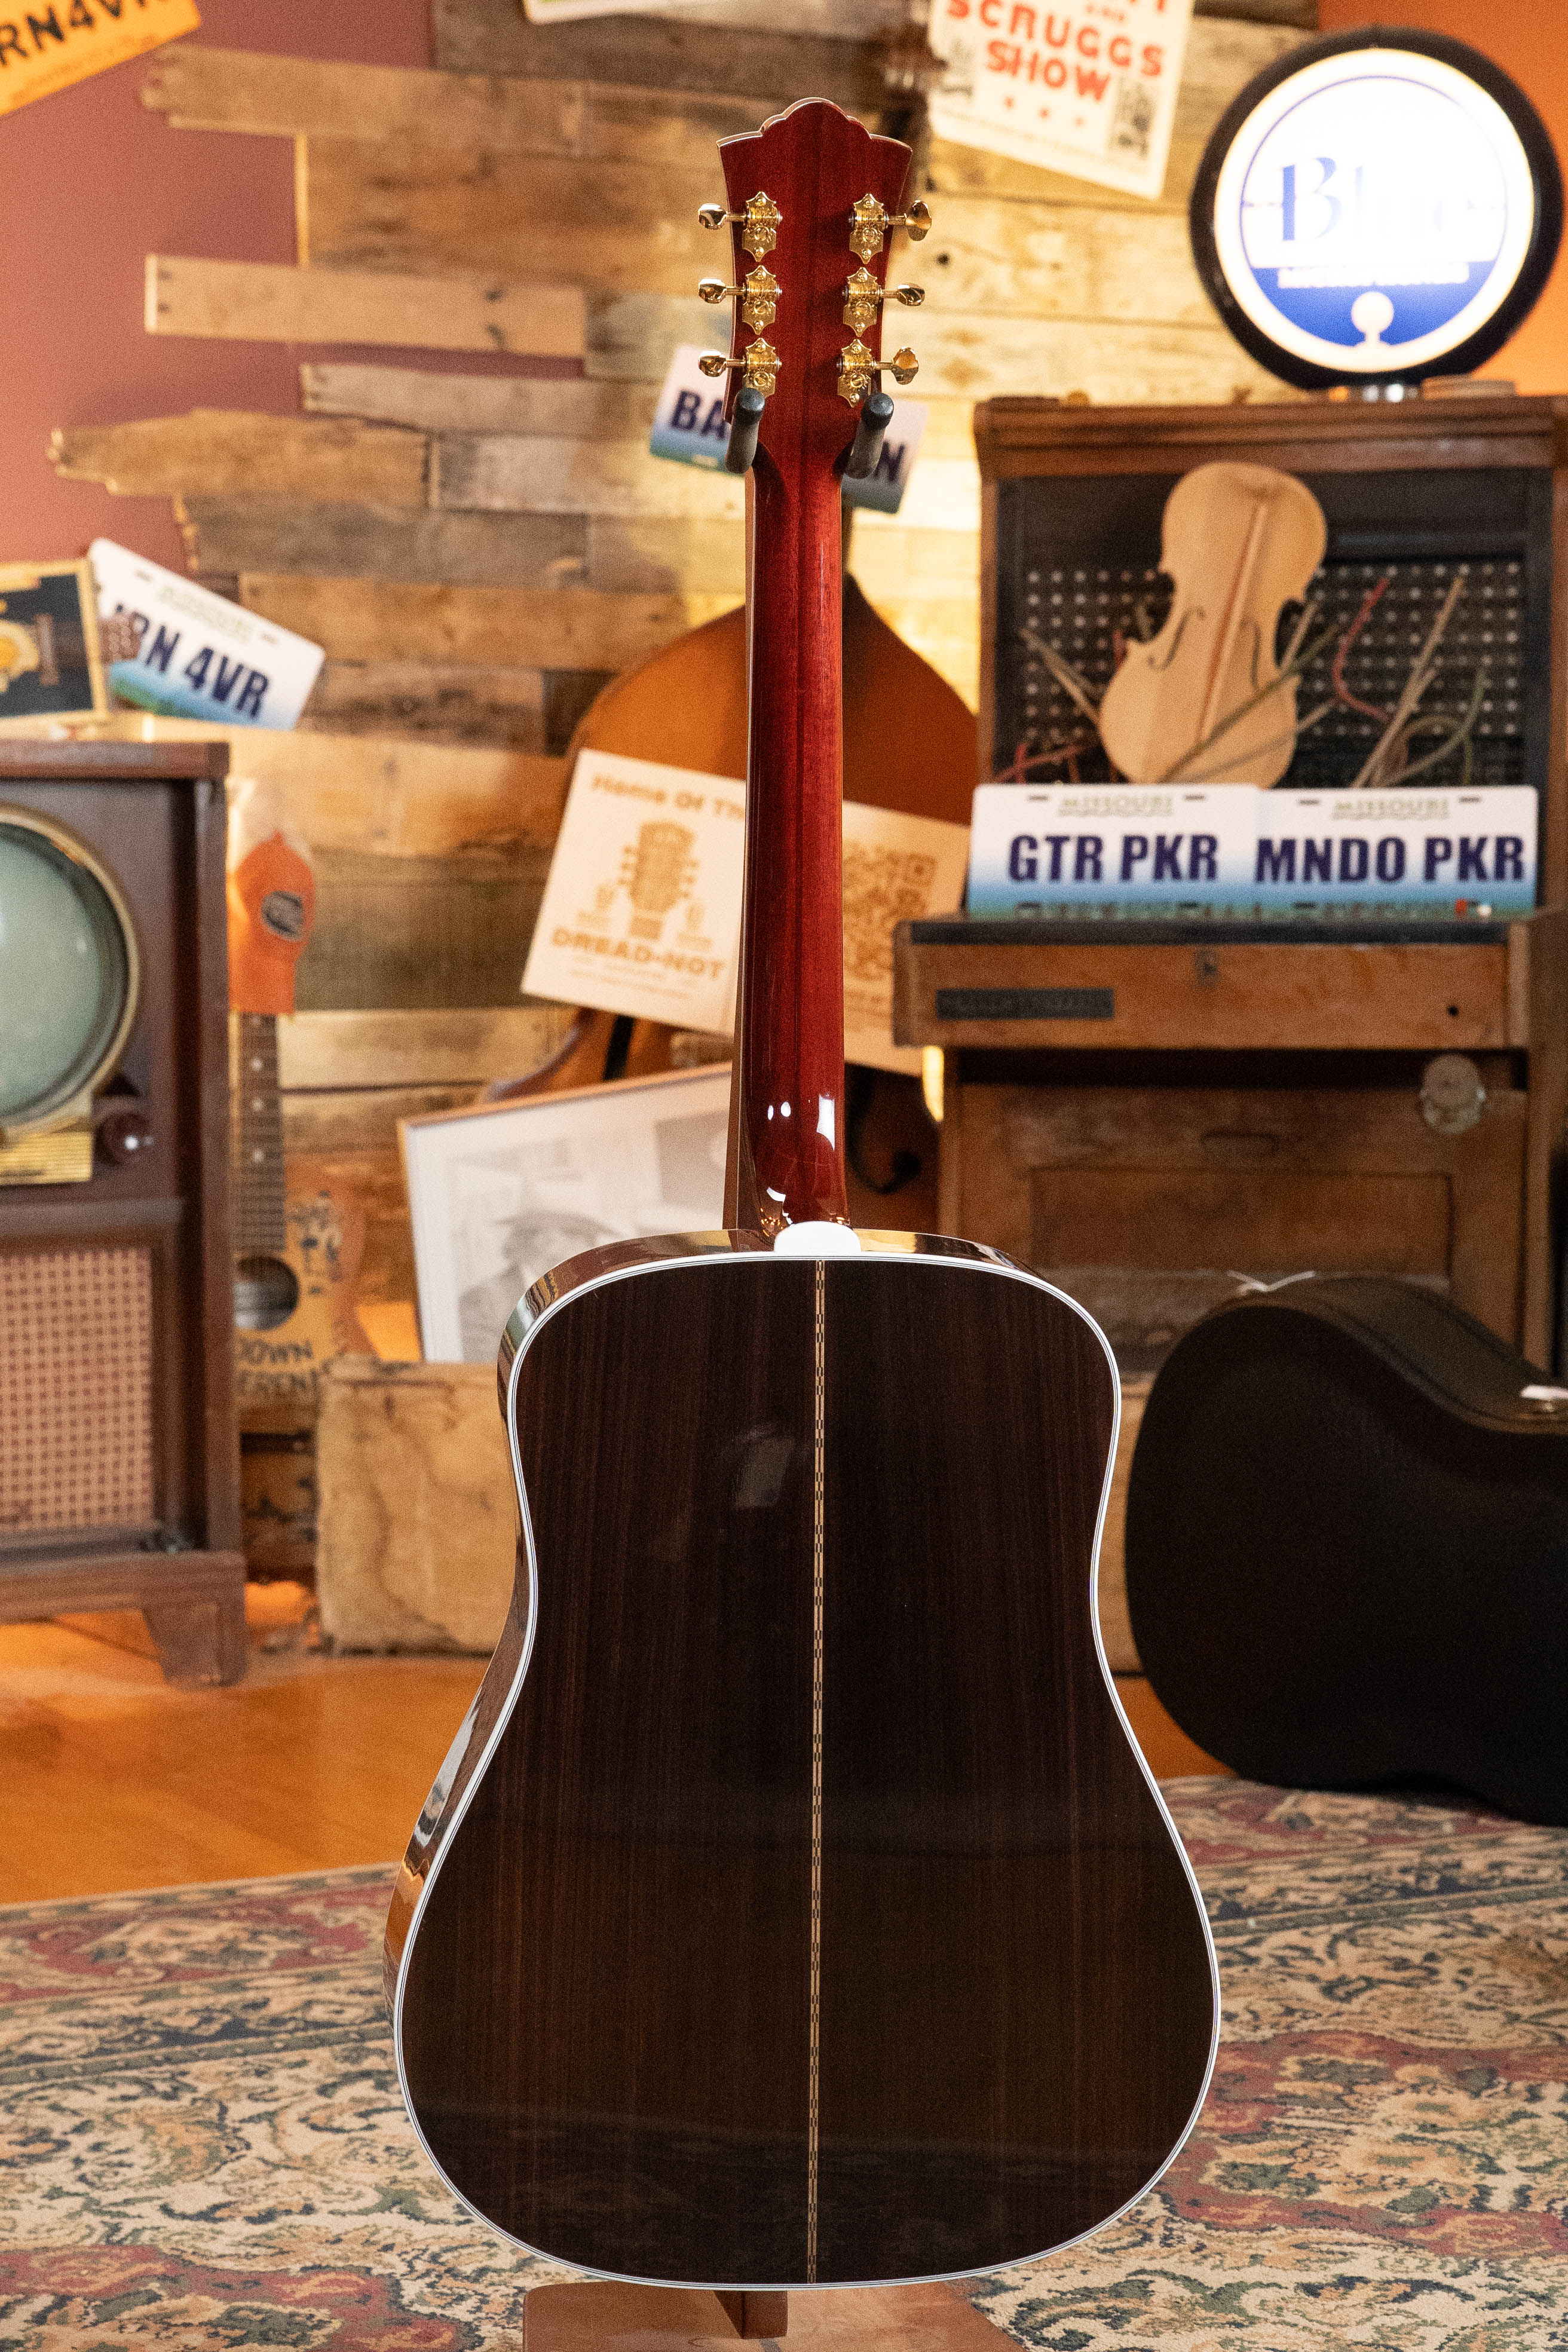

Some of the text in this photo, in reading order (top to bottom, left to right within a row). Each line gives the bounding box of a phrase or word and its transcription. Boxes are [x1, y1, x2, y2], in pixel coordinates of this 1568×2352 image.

[948, 0, 1164, 77] SCRUGGS
[986, 39, 1110, 102] SHOW
[184, 646, 270, 719] 4VR
[1008, 834, 1218, 883] GTR PKR
[1255, 835, 1523, 883] MNDO PKR
